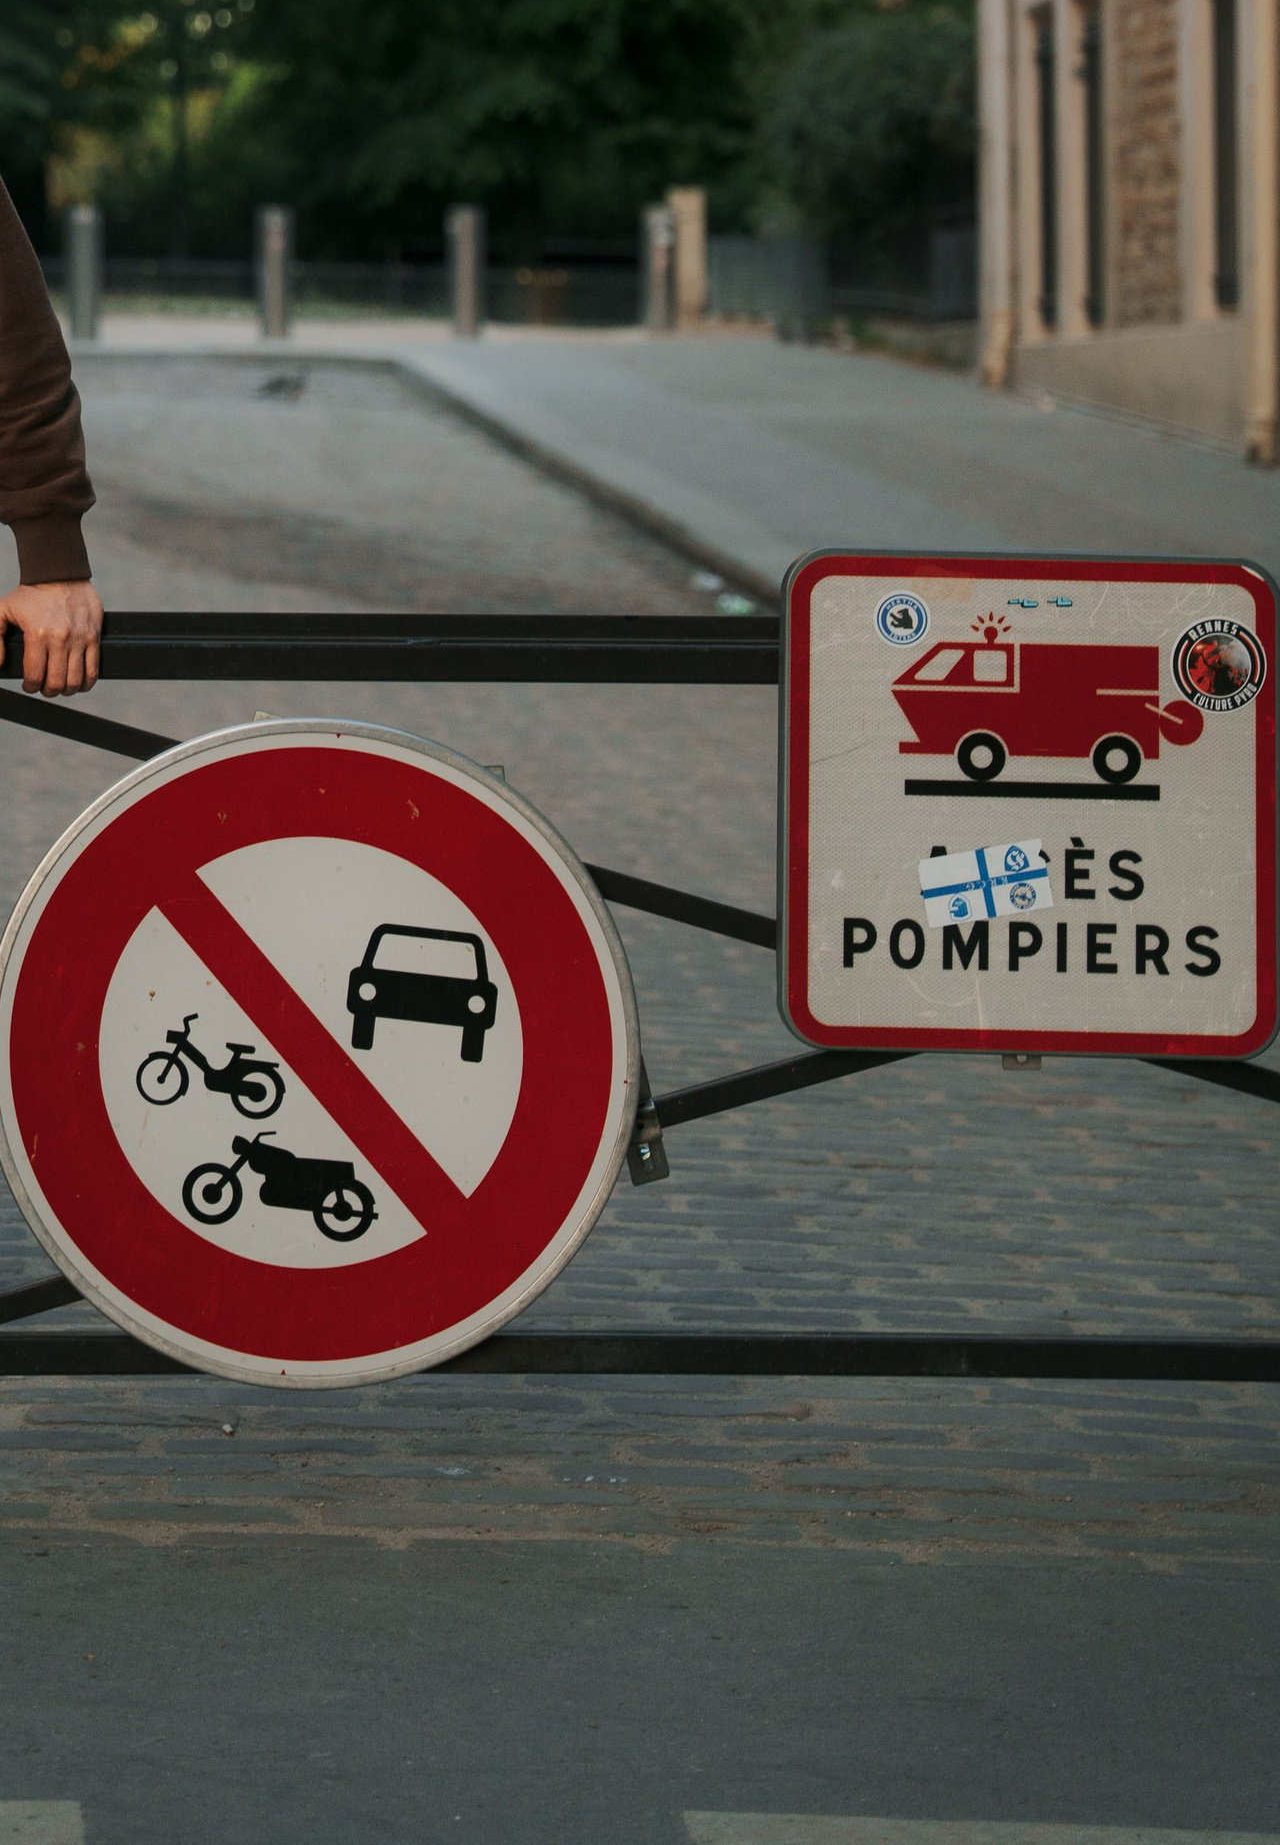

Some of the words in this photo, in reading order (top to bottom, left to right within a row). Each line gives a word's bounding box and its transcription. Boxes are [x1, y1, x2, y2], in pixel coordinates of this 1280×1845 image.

[1188, 620, 1238, 641] RENNES
[1193, 692, 1233, 711] CULTURE
[1234, 682, 1258, 706] PYRO
[842, 917, 1222, 978] POMPIERS
